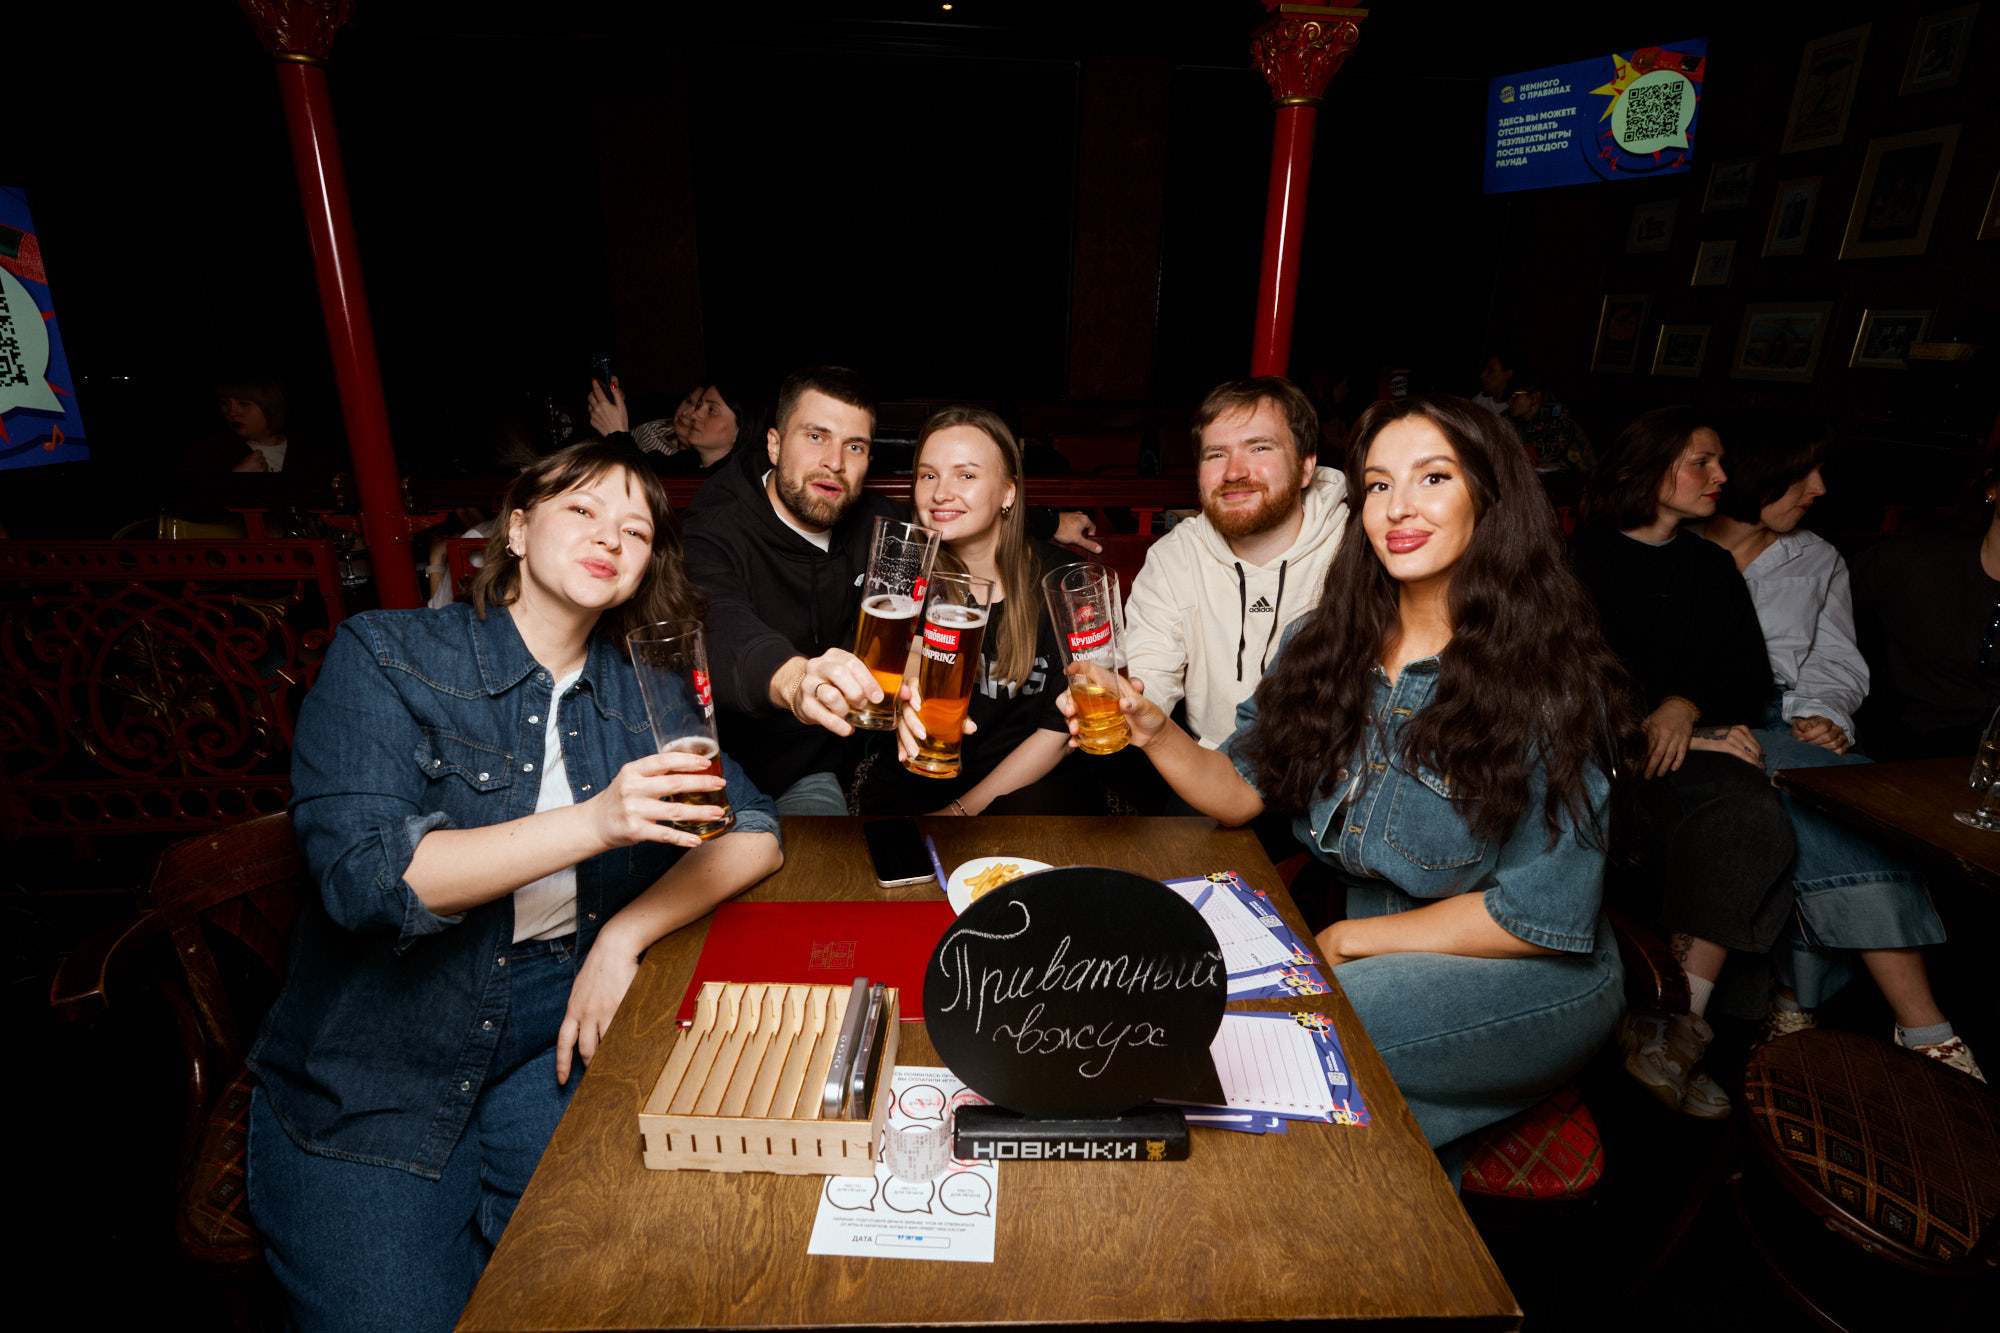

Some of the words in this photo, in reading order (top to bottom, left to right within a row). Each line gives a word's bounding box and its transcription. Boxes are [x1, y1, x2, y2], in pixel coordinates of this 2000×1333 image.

[1519, 78, 1560, 92] НЕМНОГО
[1519, 92, 1527, 100] О
[1527, 84, 1571, 99] ПРАВИЛАХ
[1498, 116, 1525, 127] ЗДЕСЬ
[1525, 113, 1539, 123] ВЫ
[1539, 106, 1577, 120] МОЖЕТЕ
[1497, 121, 1559, 137] ОТСЛЕЖИВАТЬ
[1497, 132, 1547, 147] РЕЗУЛЬТАТЫ
[1547, 129, 1572, 139] ИГРЫ
[1496, 146, 1525, 158] ПОСЛЕ
[1525, 140, 1569, 154] КАЖДОГО
[1495, 156, 1528, 168] РАУНДА
[939, 900, 1223, 1034] Приватный
[973, 1141, 1137, 1160] НОВИЧКИ
[851, 1235, 873, 1243] ДАТА
